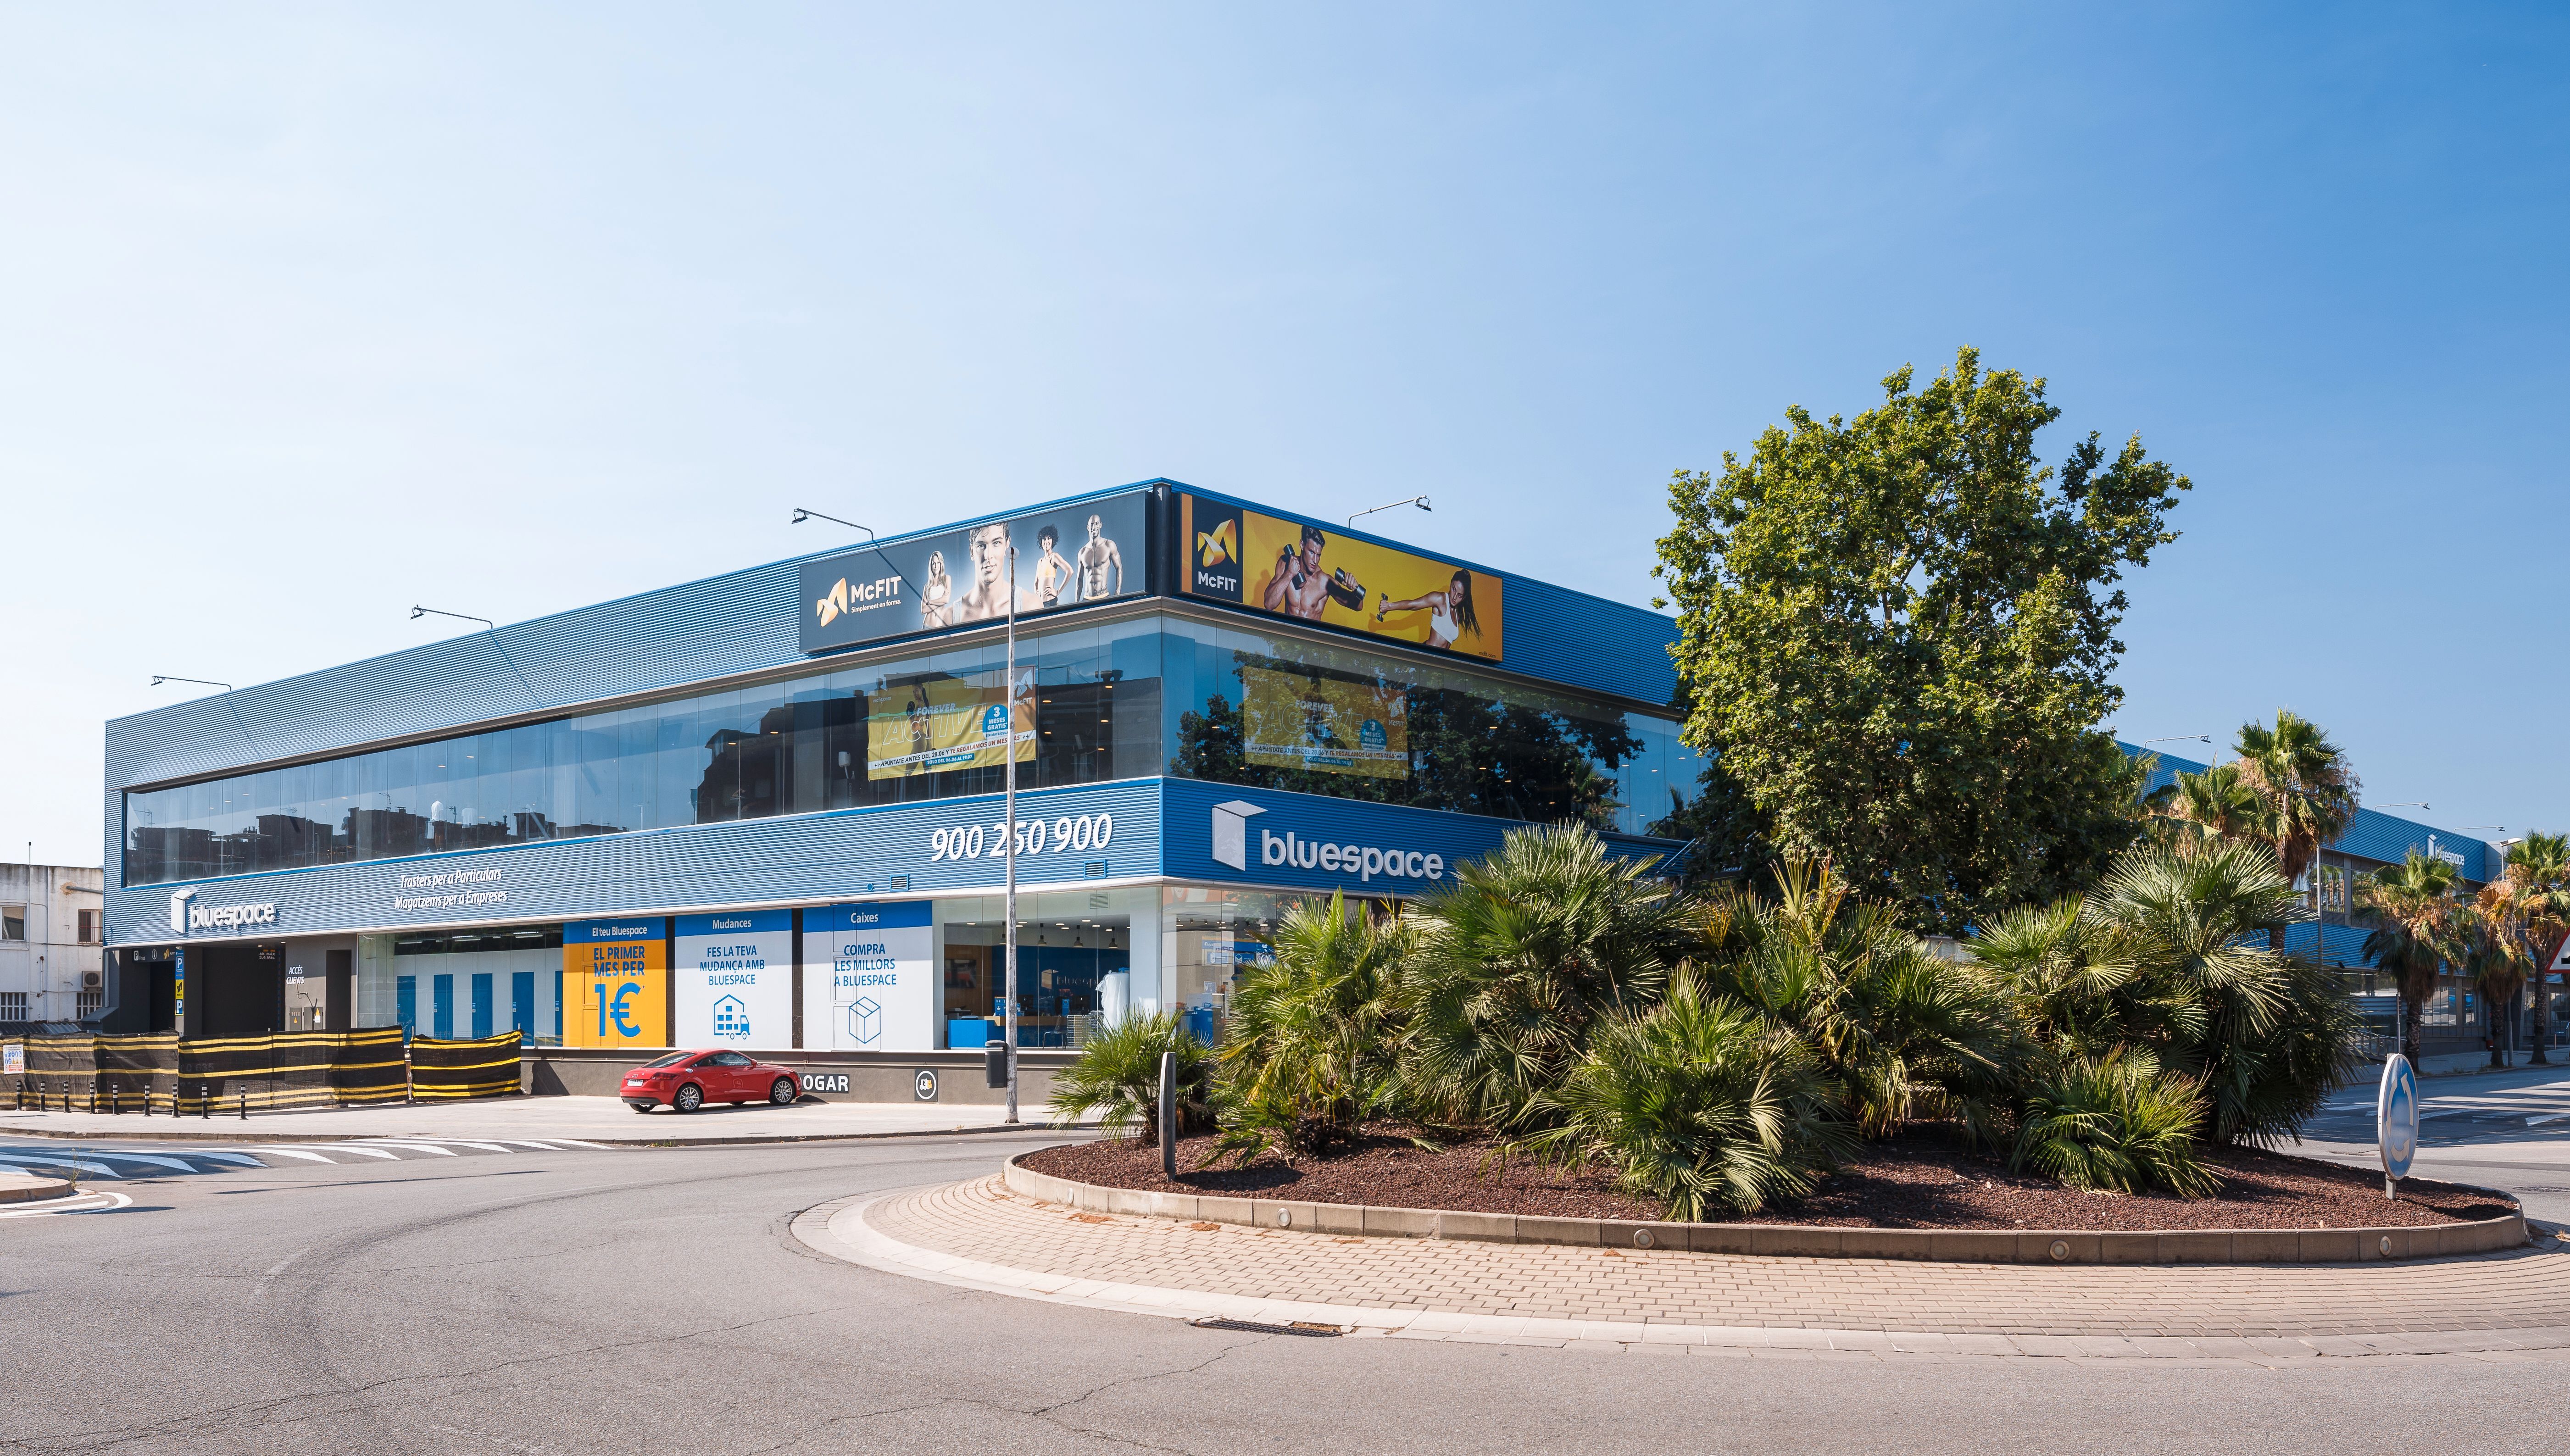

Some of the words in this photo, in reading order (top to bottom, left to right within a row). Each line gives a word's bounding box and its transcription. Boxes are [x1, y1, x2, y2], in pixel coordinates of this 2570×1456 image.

[1198, 571, 1236, 592] McFIT
[851, 576, 901, 603] McFIT
[851, 603, 879, 613] Simplement
[1014, 697, 1032, 706] McFIT
[1295, 700, 1334, 711] FOREVER
[917, 703, 956, 716] FOREVER
[993, 706, 1000, 717] 3
[883, 703, 986, 745] ACTIVE
[1370, 721, 1375, 731] 3
[957, 742, 987, 753] REGALAMOS
[931, 825, 984, 861] 900
[989, 820, 1046, 857] 250
[1054, 814, 1113, 852] 900
[1262, 829, 1444, 881] bluespace
[400, 874, 431, 888] Trasters
[432, 873, 448, 889] per
[448, 874, 455, 884] a
[455, 866, 503, 884] Particulars
[395, 895, 444, 912] Magatzems
[443, 895, 459, 909] per
[458, 894, 465, 905] a
[466, 890, 507, 906] Empreses
[190, 902, 276, 930] bluespace
[851, 912, 878, 923] Caixes
[712, 918, 751, 929] Mudances
[592, 927, 598, 937] El
[599, 928, 611, 936] teu
[612, 926, 647, 937] Bluespace
[594, 948, 605, 960] EL
[607, 946, 645, 959] PRIMER
[707, 947, 721, 957] FES
[723, 946, 734, 956] LA
[735, 945, 757, 956] TEVA
[844, 943, 885, 956] COMPRA
[177, 958, 182, 968] P
[594, 961, 619, 977] MES
[622, 961, 645, 976] PER
[700, 960, 743, 973] MUDANÇA
[745, 959, 765, 970] AMB
[835, 960, 851, 971] LES
[853, 958, 895, 970] MILLORS
[289, 965, 303, 974] ACCÉS
[286, 976, 304, 984] CLIENTS
[709, 974, 755, 985] BLUESPACE
[834, 976, 840, 986] A
[843, 974, 896, 986] BLUESPACE
[1057, 976, 1097, 988] bluesp
[177, 1000, 182, 1014] P
[803, 1075, 848, 1091] OGAR
